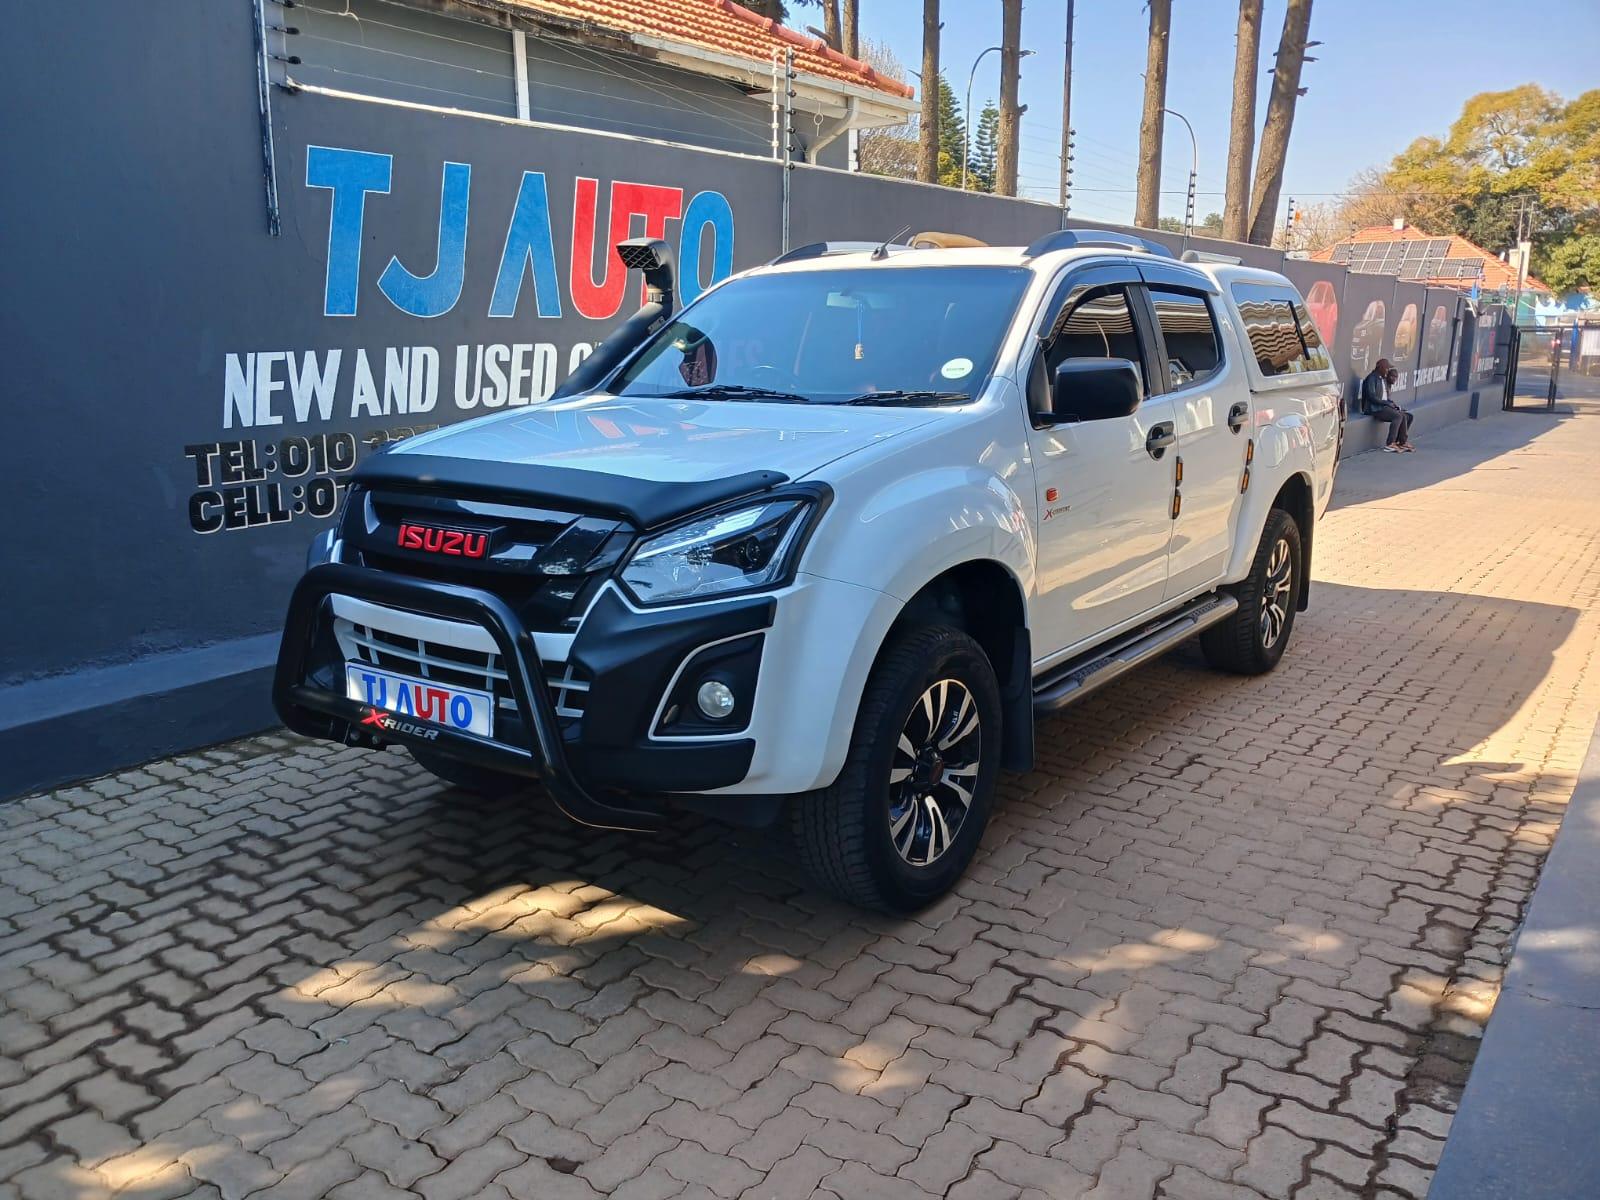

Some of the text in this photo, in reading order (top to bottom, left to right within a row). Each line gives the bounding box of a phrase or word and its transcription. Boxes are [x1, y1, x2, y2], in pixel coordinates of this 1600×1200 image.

[305, 144, 735, 320] TJ AUTO
[223, 349, 342, 429] NEW
[350, 346, 440, 417] AND
[454, 343, 558, 410] USED
[188, 476, 352, 535] CELL:0
[397, 524, 486, 559] ISUZU
[360, 708, 440, 741] X-RIDER
[396, 682, 473, 729] AUTO
